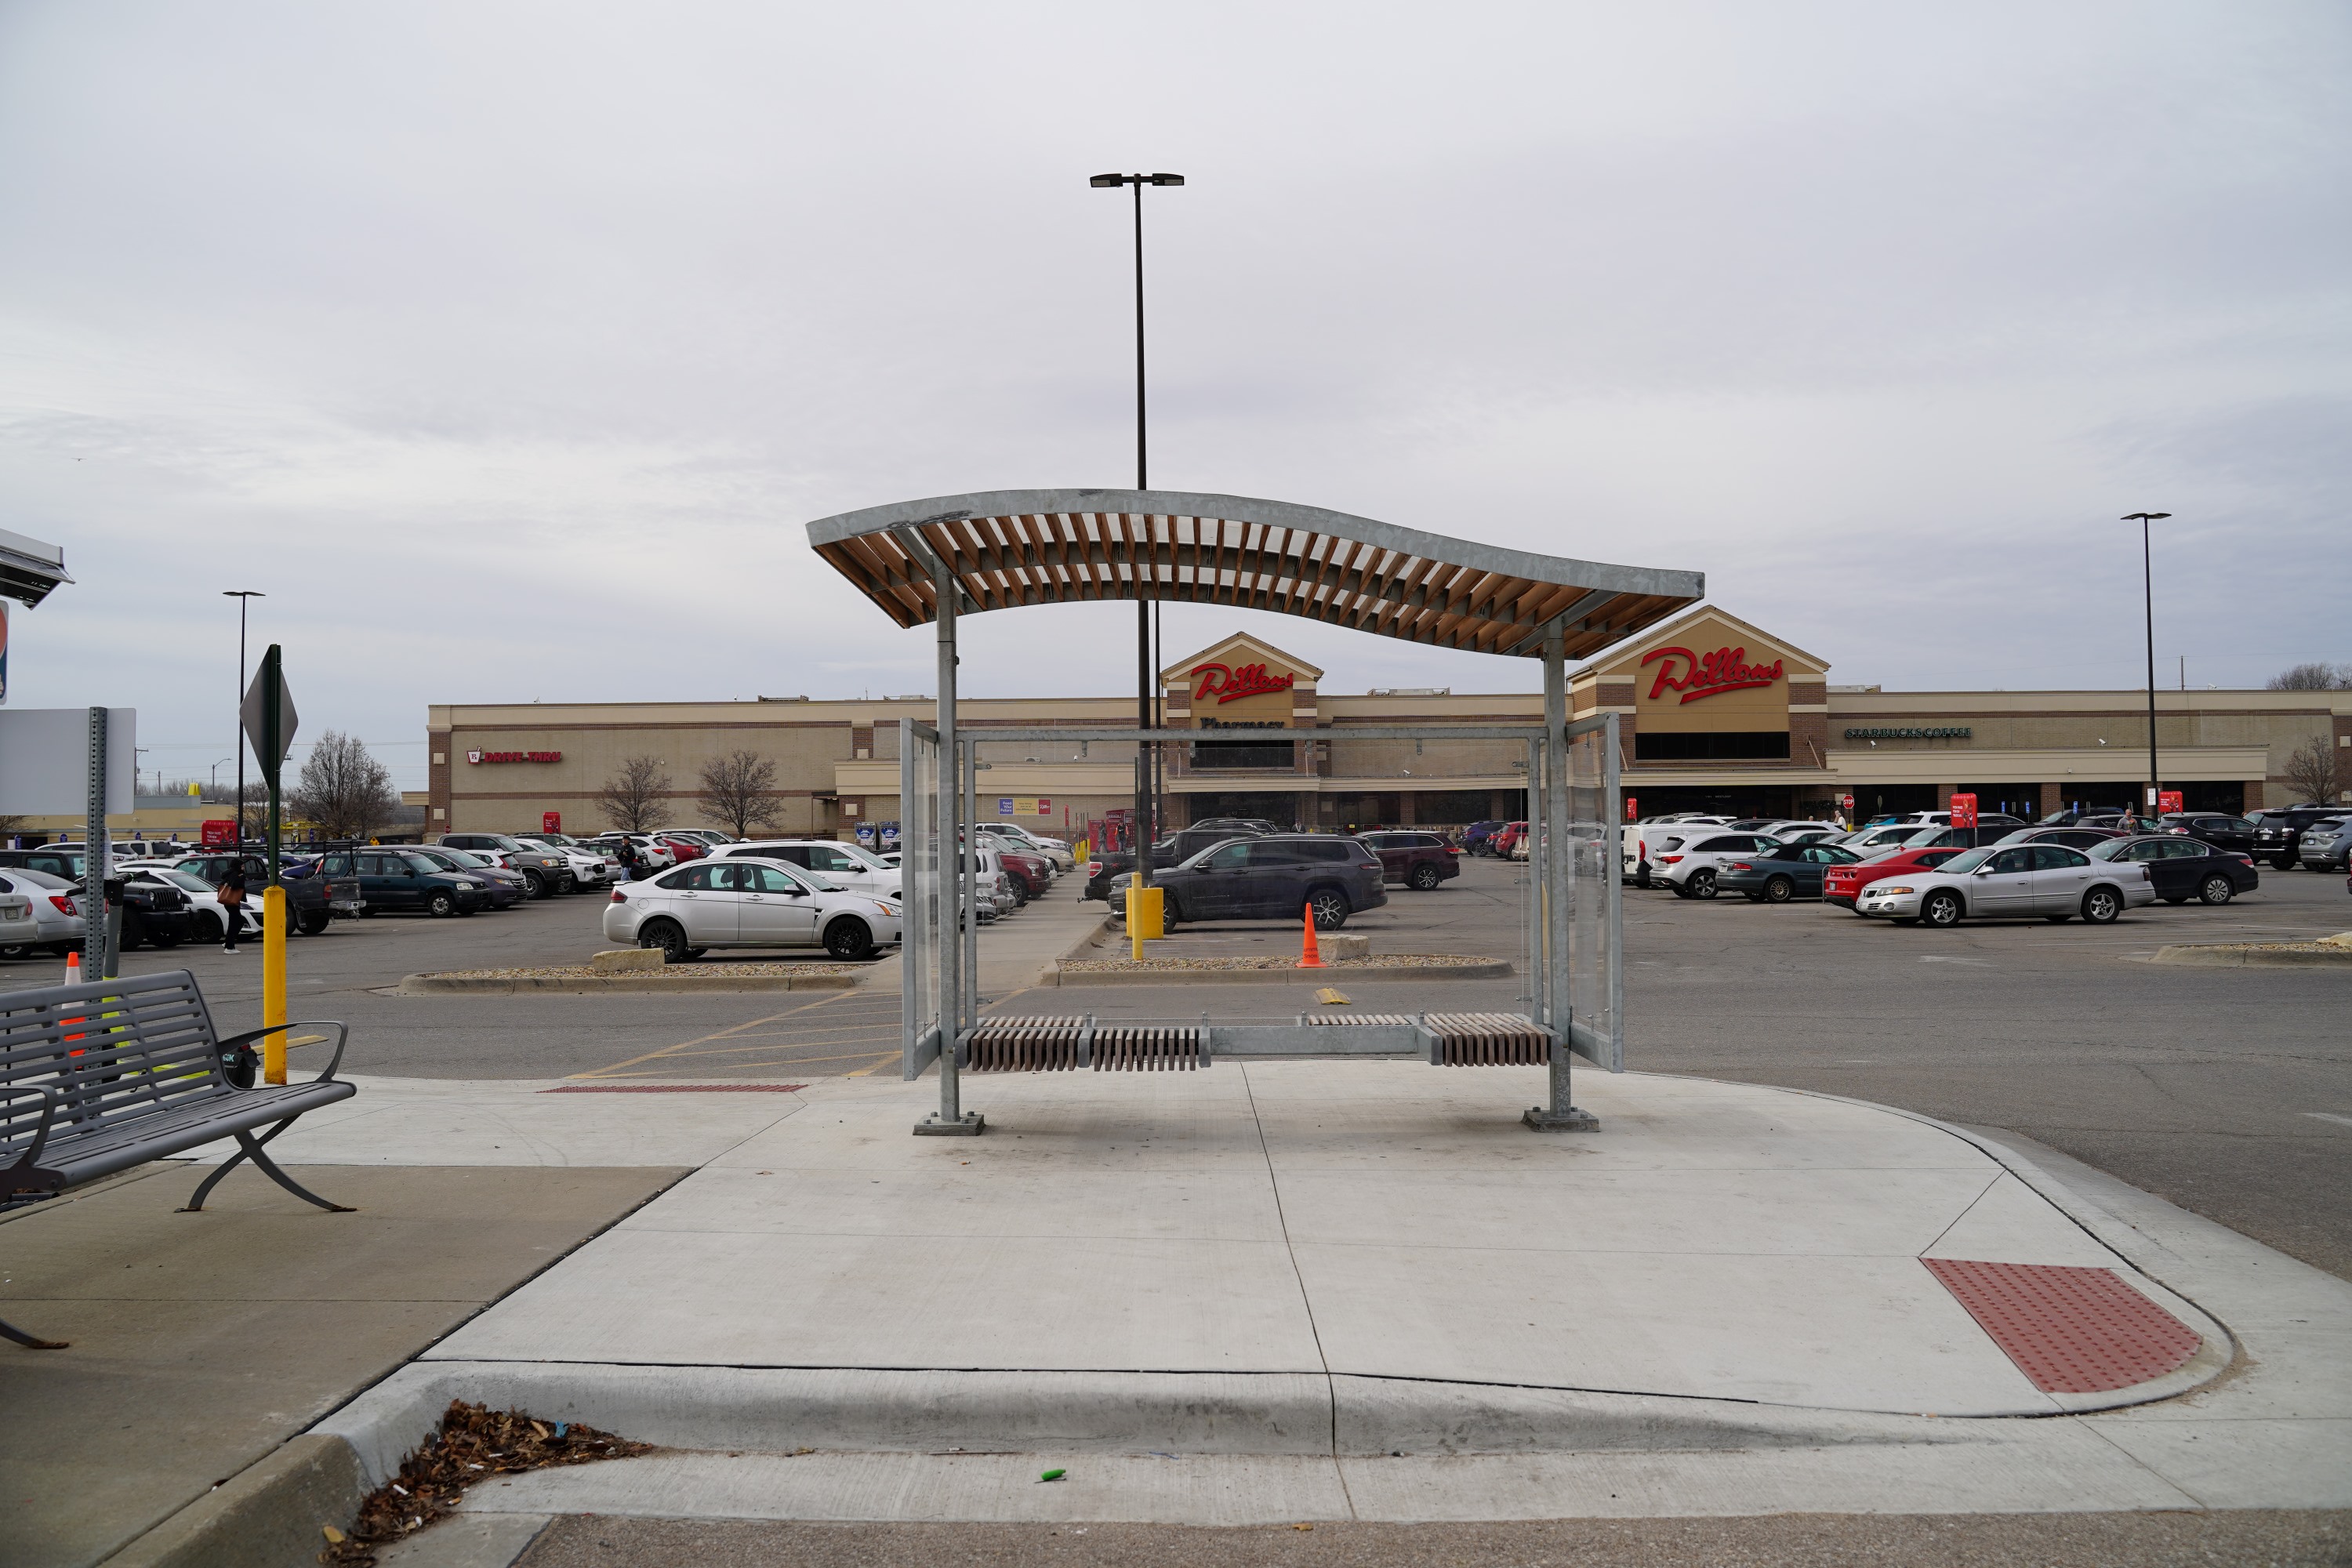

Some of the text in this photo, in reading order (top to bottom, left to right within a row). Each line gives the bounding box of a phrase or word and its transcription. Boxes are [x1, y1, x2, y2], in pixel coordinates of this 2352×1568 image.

[1190, 663, 1294, 704] Dillons
[1640, 647, 1783, 705] Dillons
[1846, 728, 1972, 738] STARBUCKS COFFEE
